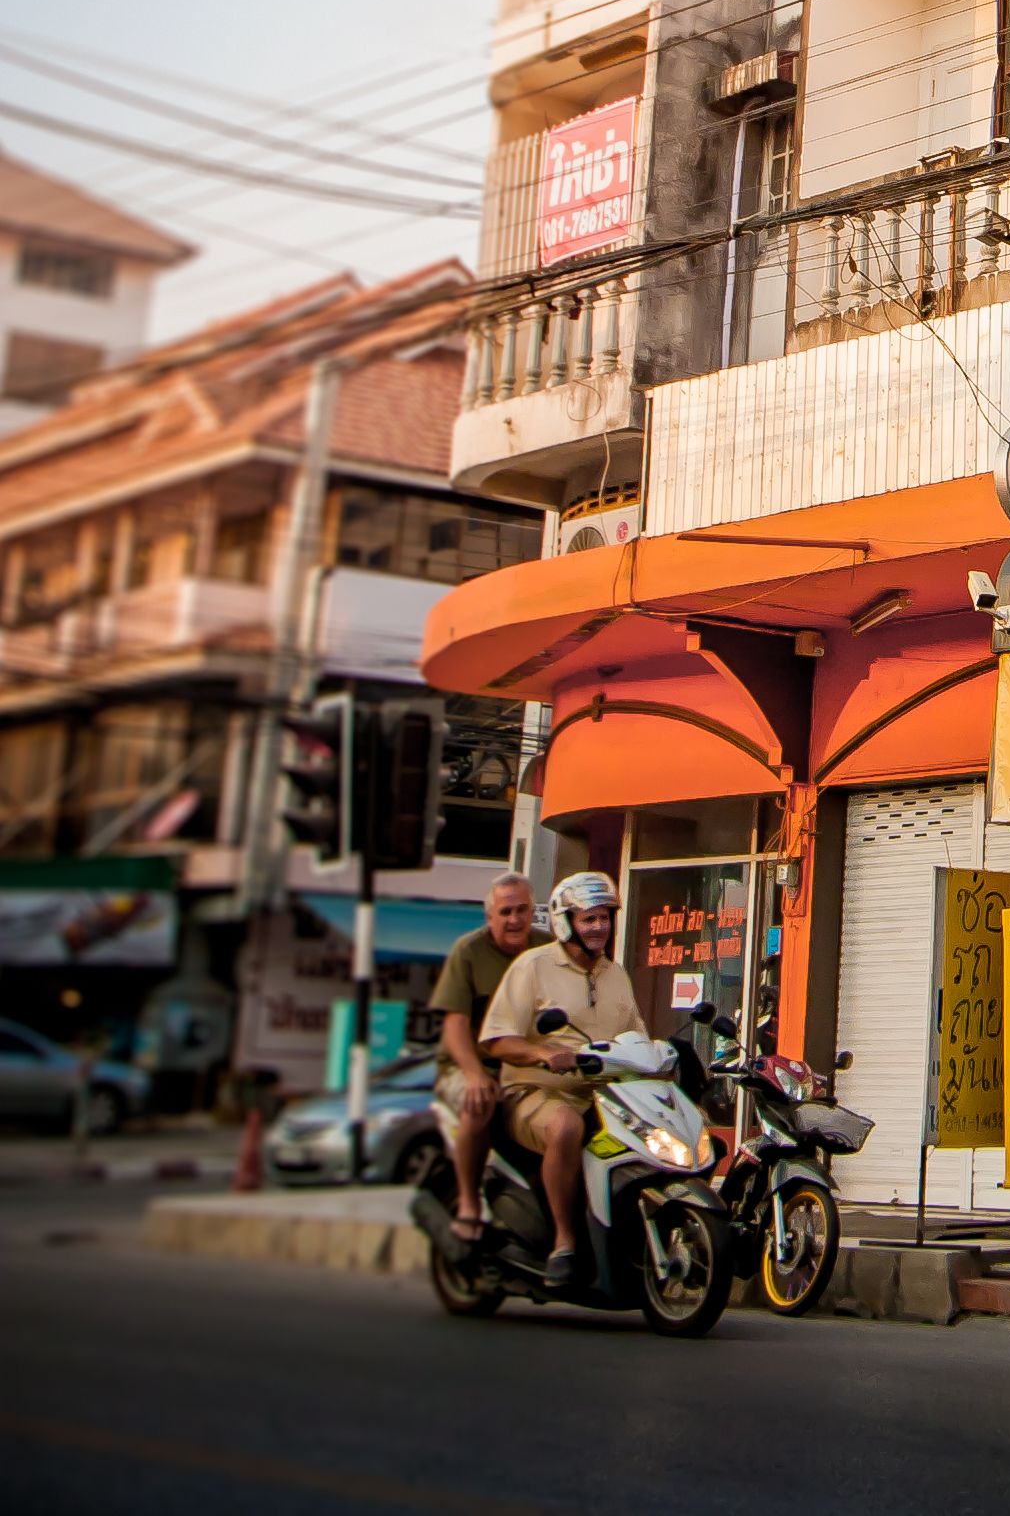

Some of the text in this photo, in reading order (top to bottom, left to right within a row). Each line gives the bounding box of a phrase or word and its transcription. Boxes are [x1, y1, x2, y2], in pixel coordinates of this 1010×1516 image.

[549, 129, 628, 207] ให้เช่า
[544, 194, 628, 247] 081-7867531
